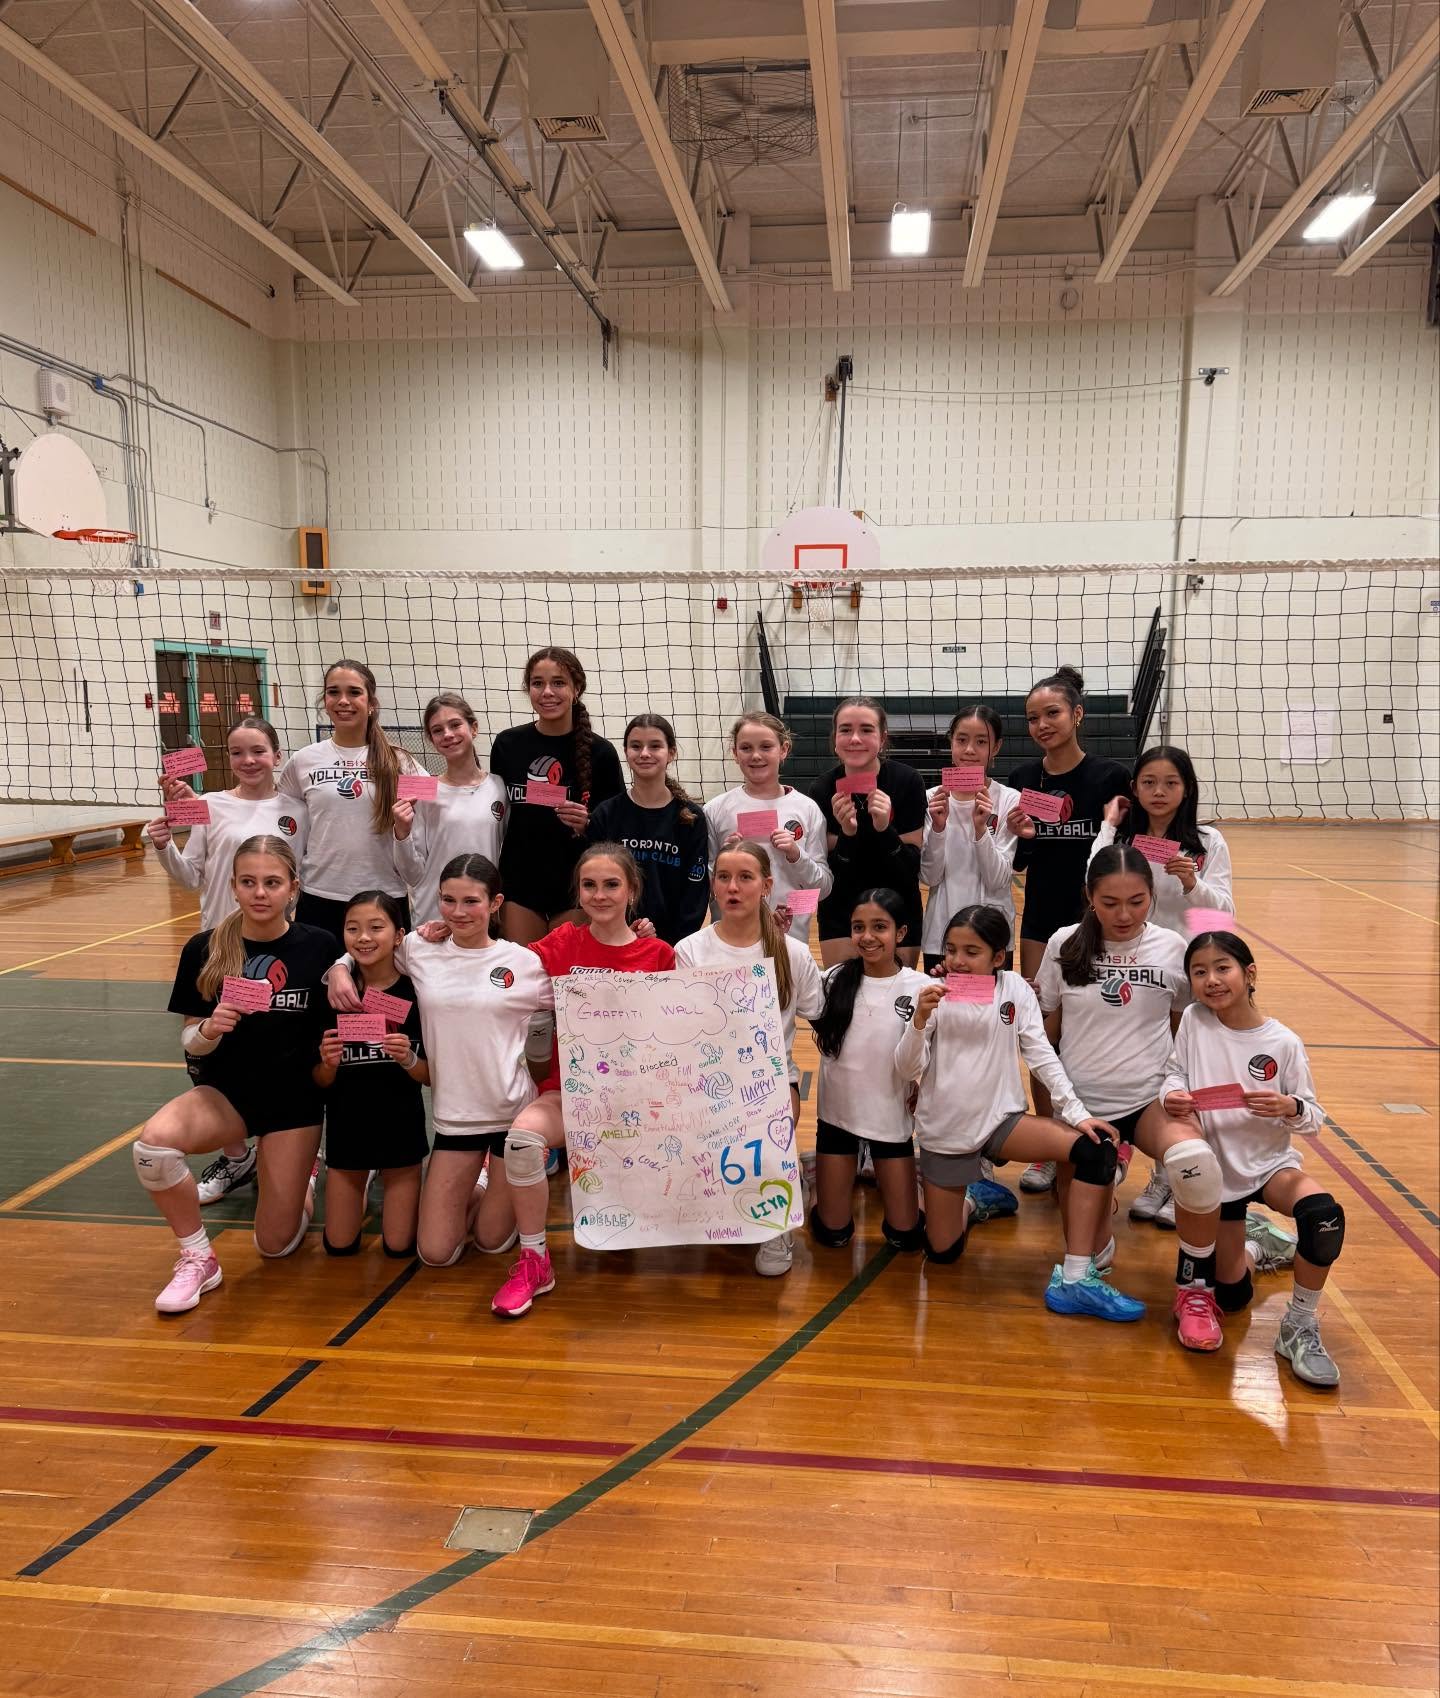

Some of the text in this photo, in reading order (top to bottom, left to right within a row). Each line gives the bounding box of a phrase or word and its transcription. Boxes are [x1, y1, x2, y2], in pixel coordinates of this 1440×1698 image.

[308, 769, 369, 786] VOLLEYB
[1037, 821, 1098, 837] LEYBALL
[621, 838, 679, 855] TORONTO
[651, 851, 681, 867] CLUB
[1095, 955, 1138, 965] 41SIX
[639, 1055, 678, 1074] Blocked
[740, 1075, 777, 1103] HAPPY!
[601, 1128, 640, 1139] AMELIA
[720, 1138, 762, 1186] 67
[750, 1194, 788, 1219] LIYA
[580, 1213, 628, 1228] ADELLE
